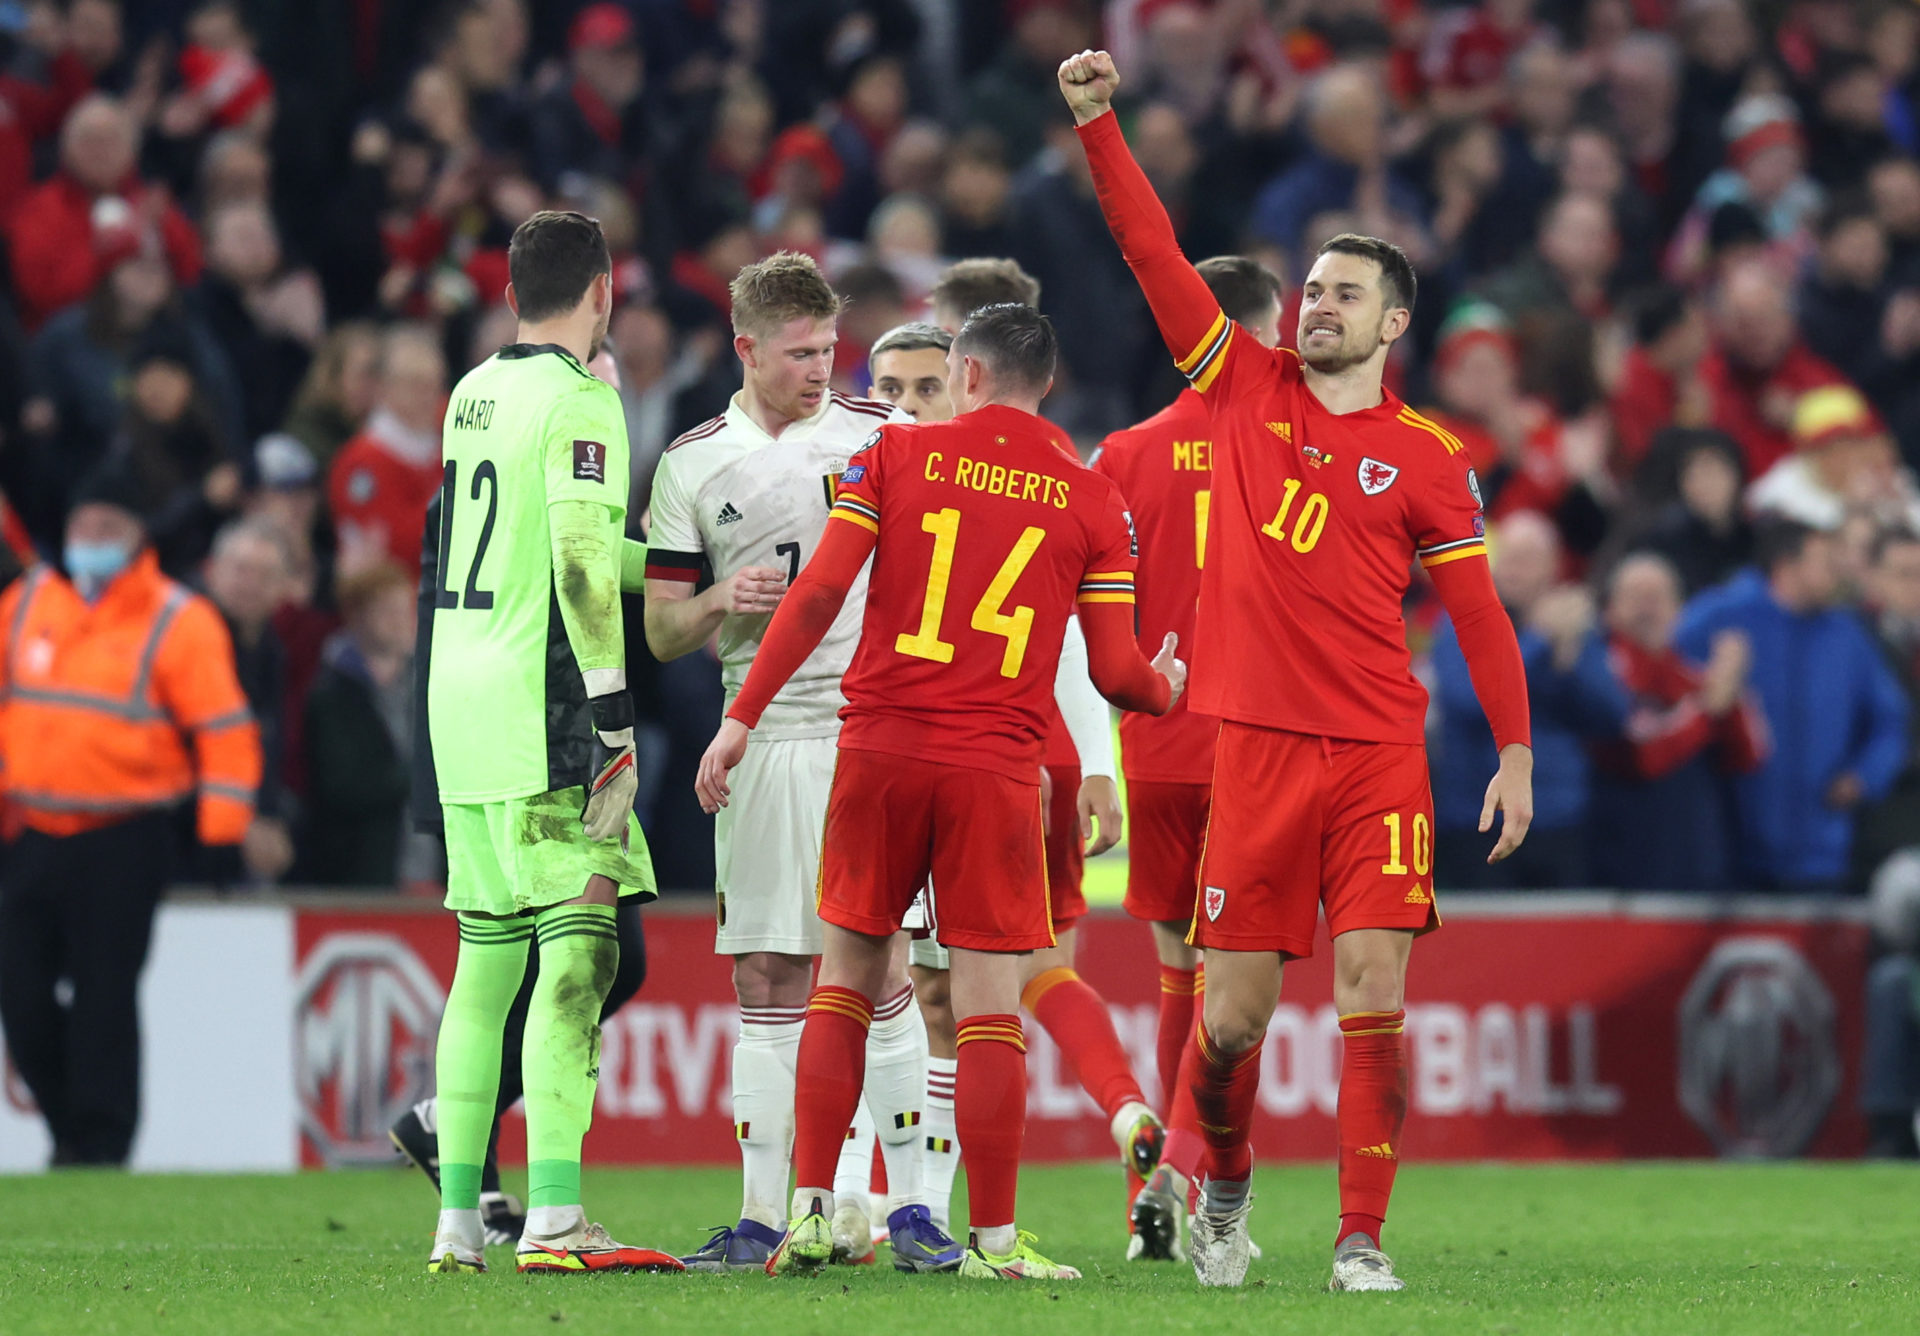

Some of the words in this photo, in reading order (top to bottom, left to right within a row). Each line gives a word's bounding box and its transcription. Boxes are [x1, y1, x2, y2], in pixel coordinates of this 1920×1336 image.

[454, 398, 495, 430] WARD
[923, 452, 945, 483] C.
[955, 456, 1070, 509] ROBERTS
[1172, 441, 1213, 471] ME
[435, 459, 498, 610] 12
[716, 512, 743, 526] adidas
[1261, 477, 1329, 553] 10
[775, 541, 800, 588] 7
[894, 507, 1046, 679] 14
[1381, 812, 1430, 876] 10
[1404, 896, 1431, 904] adidas
[1261, 1003, 1621, 1117] OOBALL
